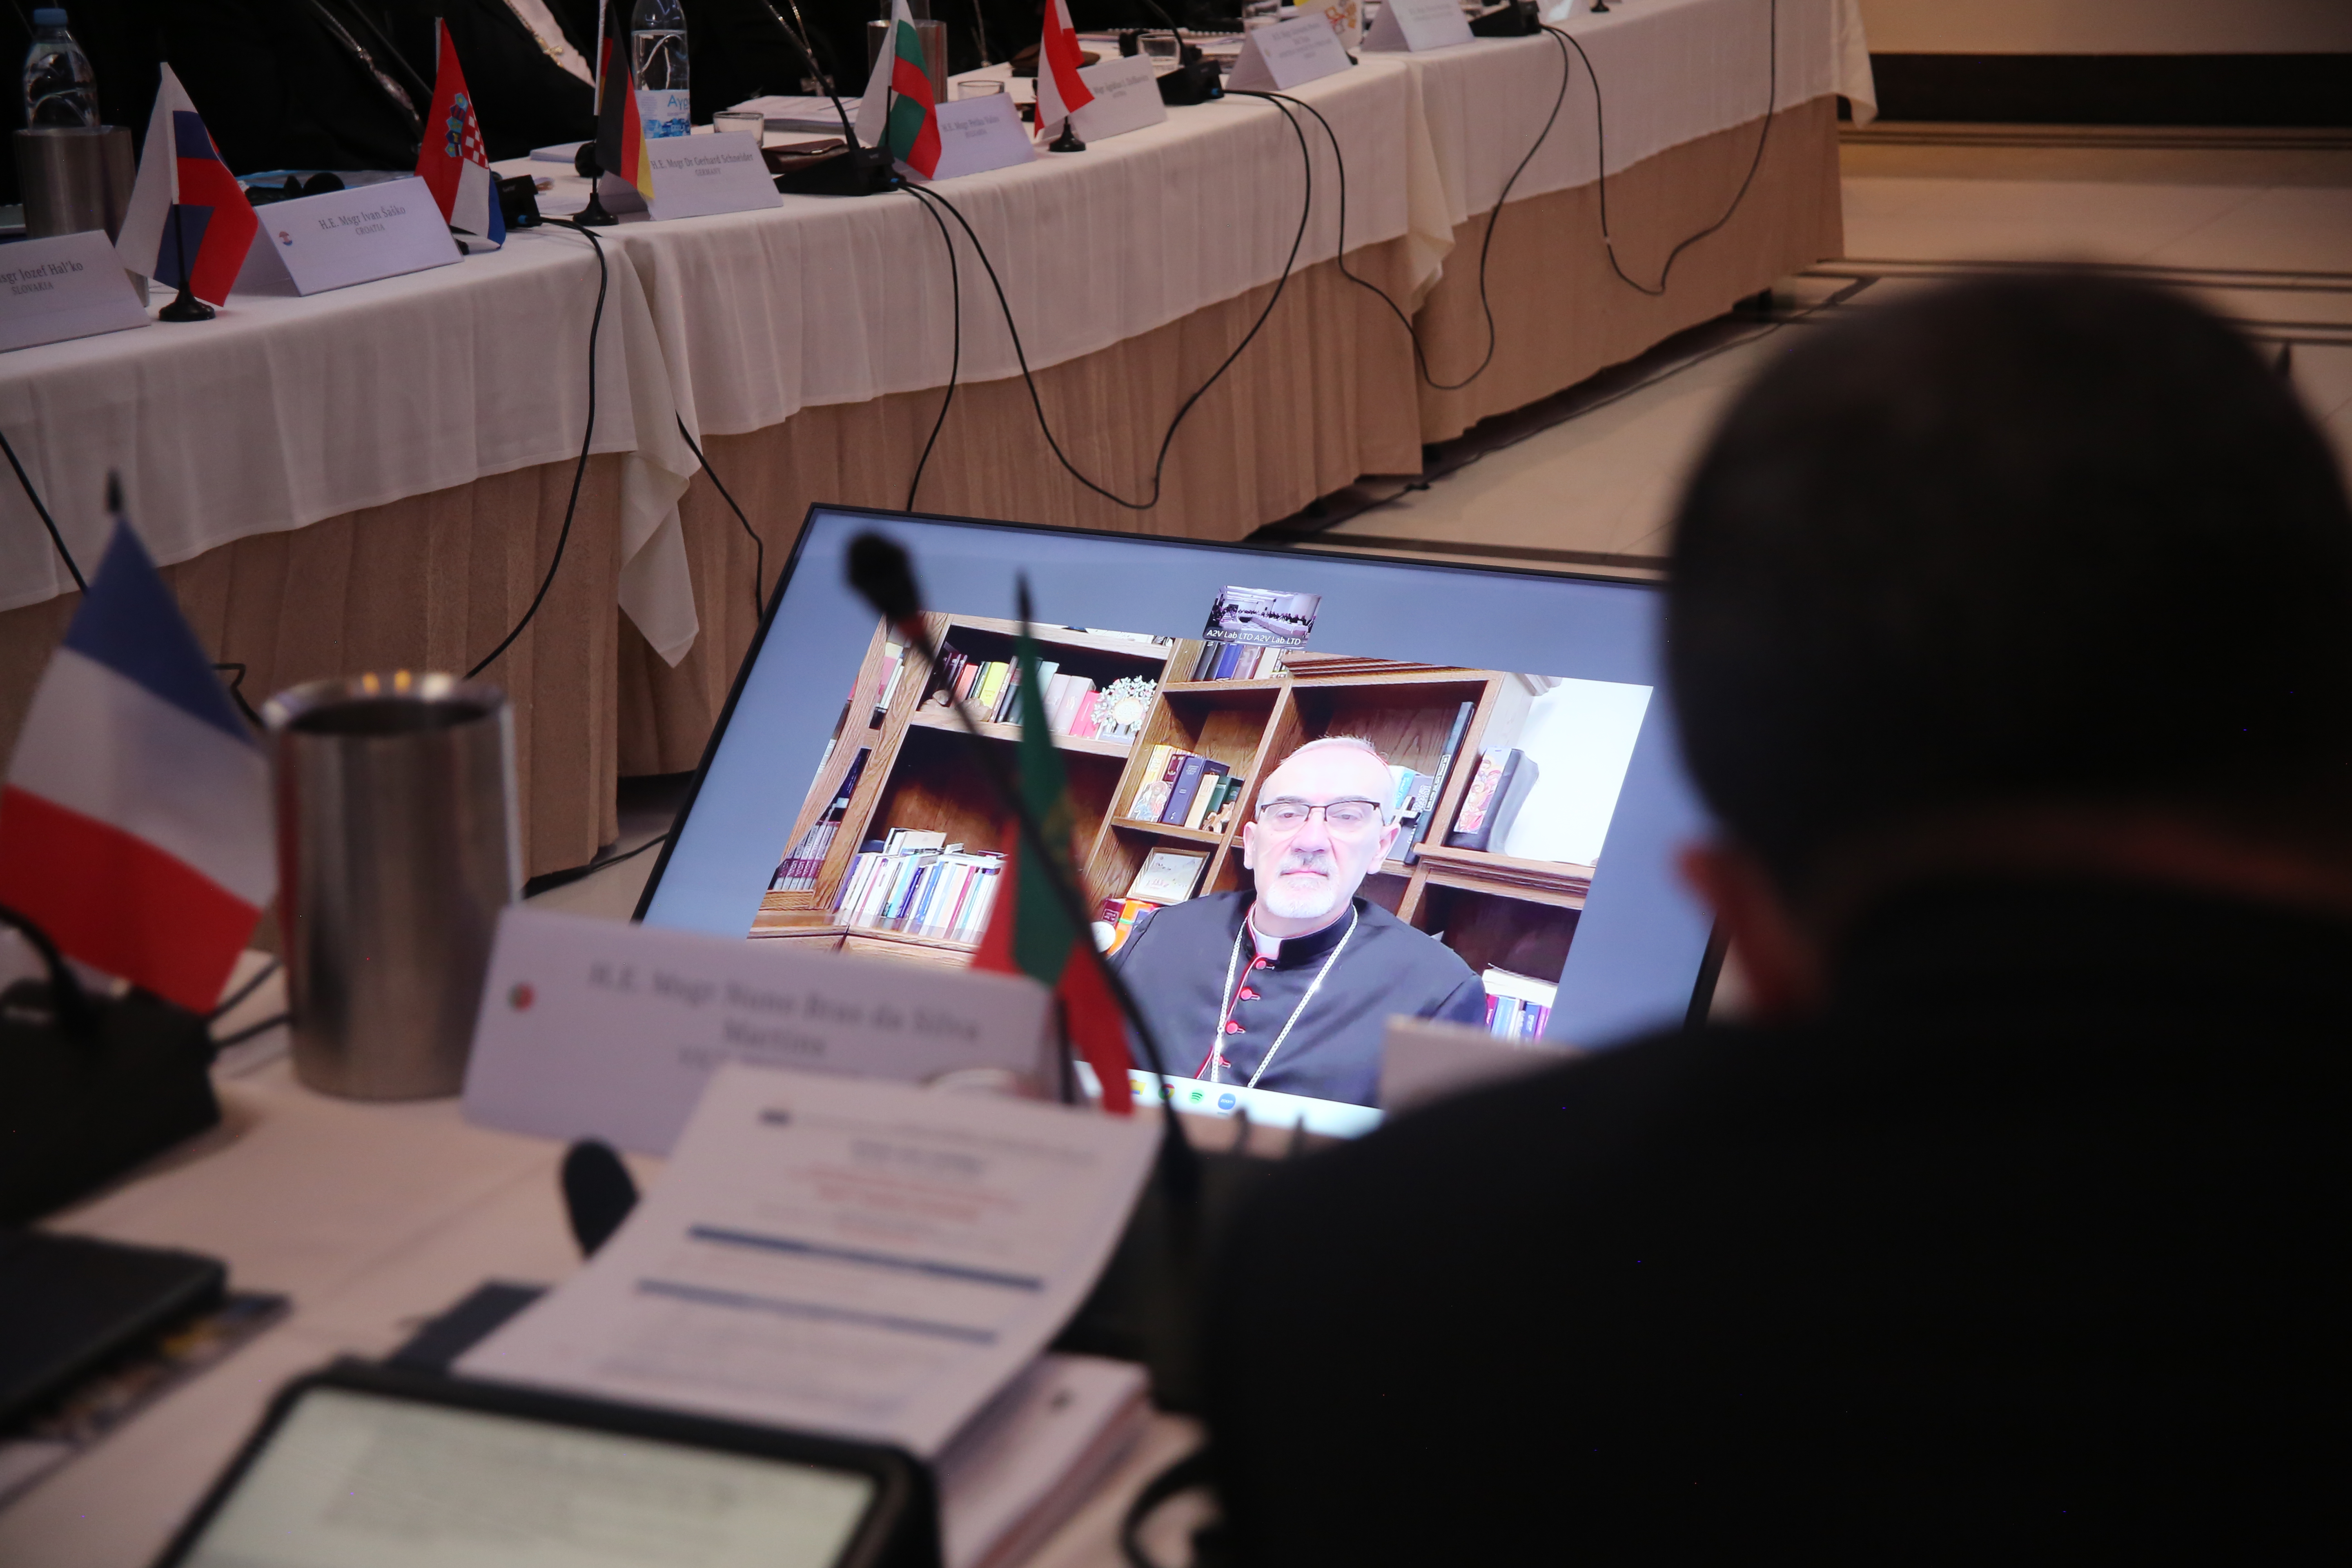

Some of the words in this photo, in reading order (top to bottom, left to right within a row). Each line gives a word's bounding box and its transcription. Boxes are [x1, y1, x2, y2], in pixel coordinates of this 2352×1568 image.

[650, 160, 667, 169] H.E.
[666, 159, 684, 169] Msgr
[684, 158, 693, 167] Dr
[694, 155, 721, 165] Gerhard
[721, 152, 753, 163] Schneider
[695, 167, 721, 176] GERMANY
[318, 218, 339, 229] H.E.
[338, 216, 361, 226] Msgr
[361, 212, 381, 221] Ivan
[380, 205, 406, 218] Šaško
[355, 223, 385, 235] CROATIA
[19, 265, 48, 281] Jozef
[11, 281, 54, 295] SLOVAKIA
